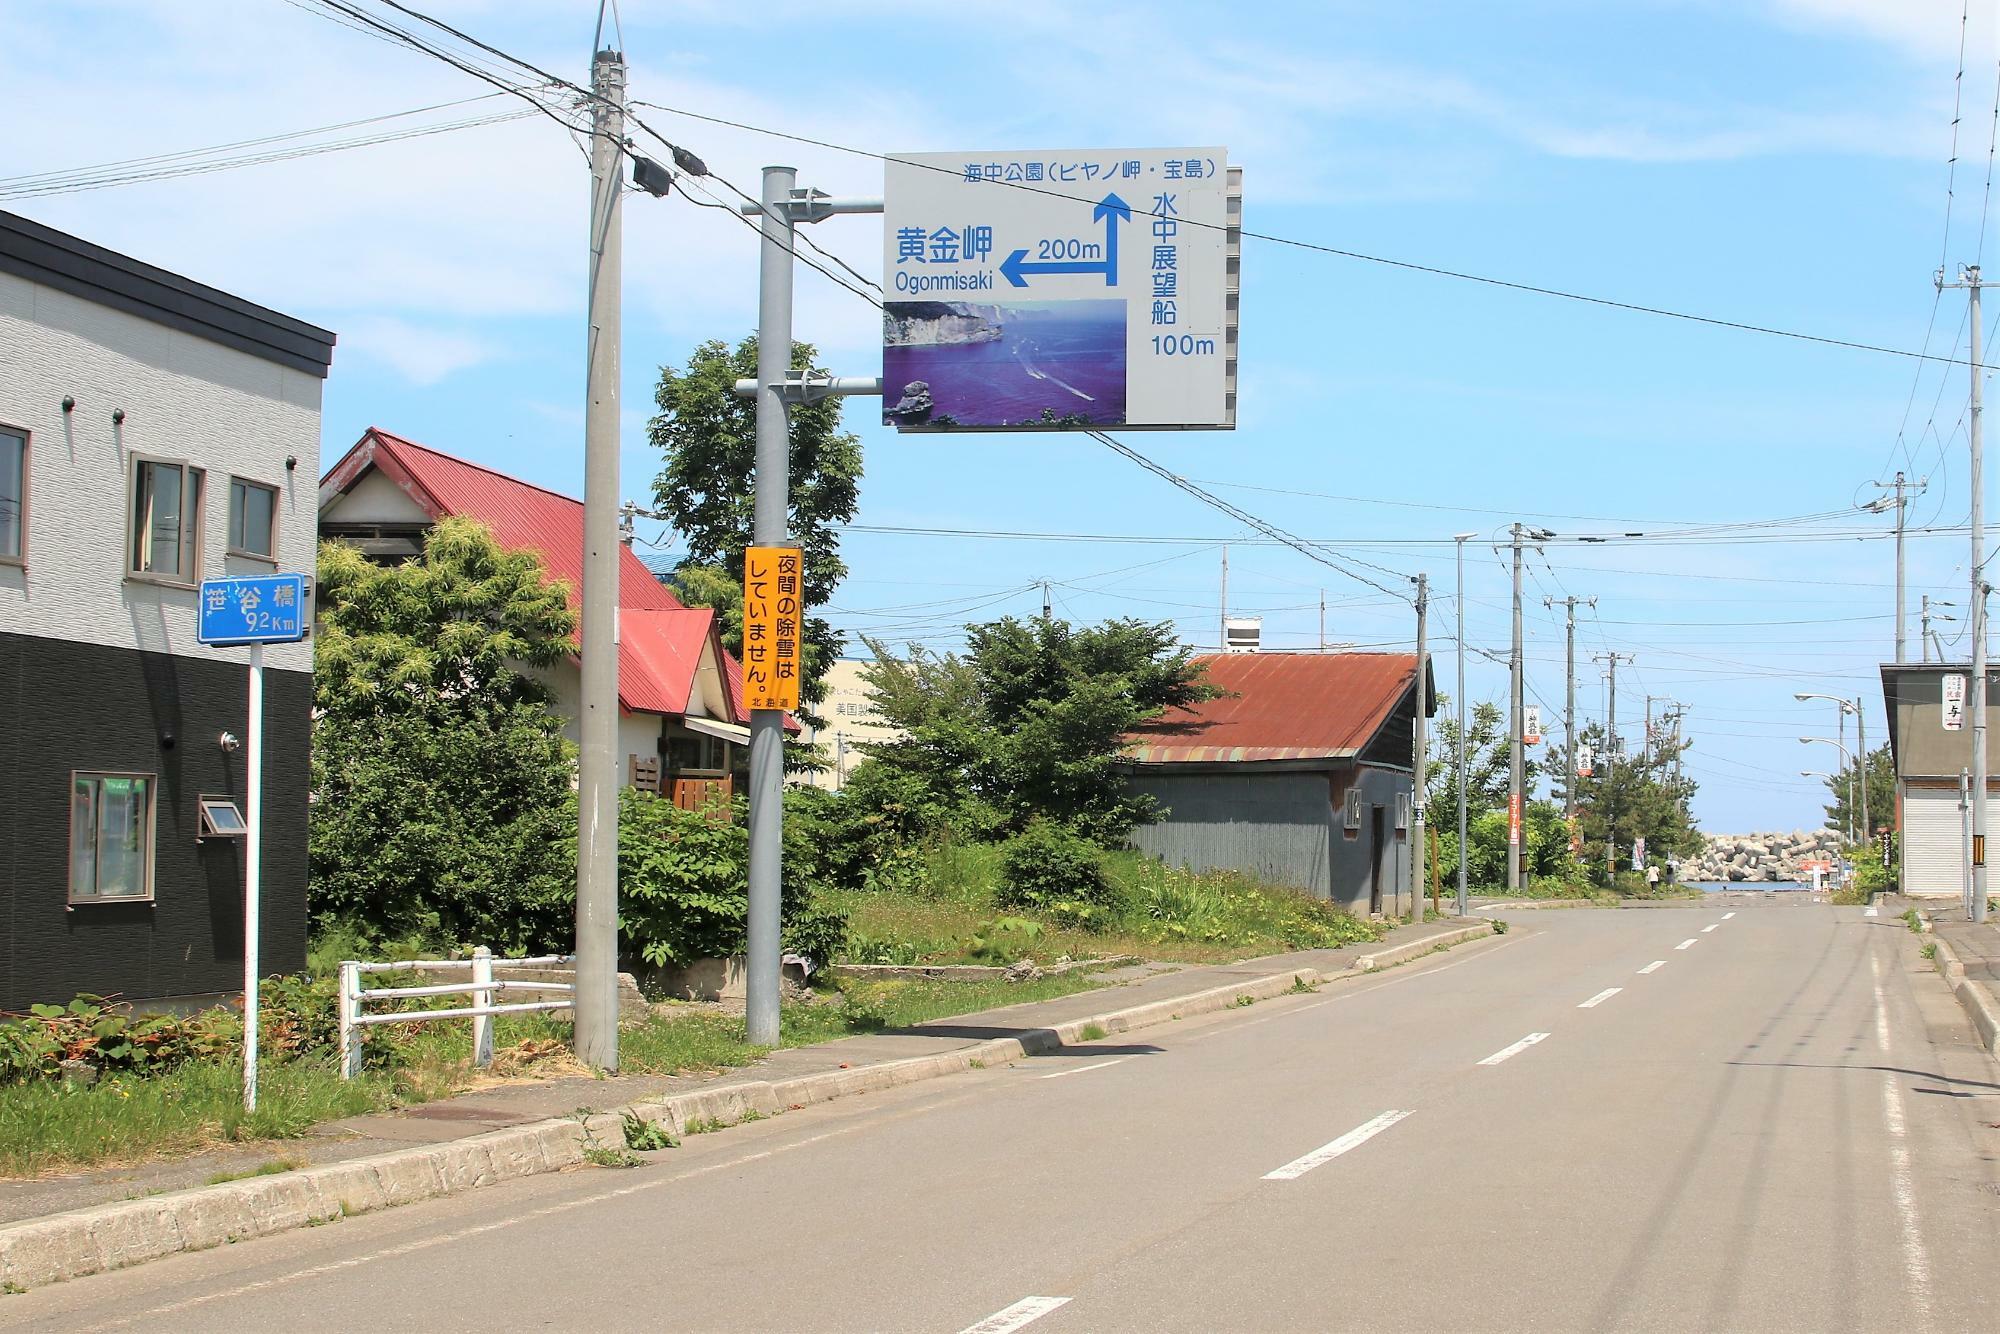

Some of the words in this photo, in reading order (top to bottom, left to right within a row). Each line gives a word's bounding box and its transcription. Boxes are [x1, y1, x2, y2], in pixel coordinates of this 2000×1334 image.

[896, 225, 993, 264] 黄金岬
[1038, 239, 1101, 260] 200m
[1151, 192, 1178, 325] 水中展望船
[896, 270, 993, 295] Ogonmisaki
[1151, 335, 1215, 356] 100m
[206, 585, 295, 611] 笹谷橋
[747, 560, 768, 693] していません。
[776, 554, 797, 679] 夜間の除雪は
[752, 697, 788, 707] 北海道
